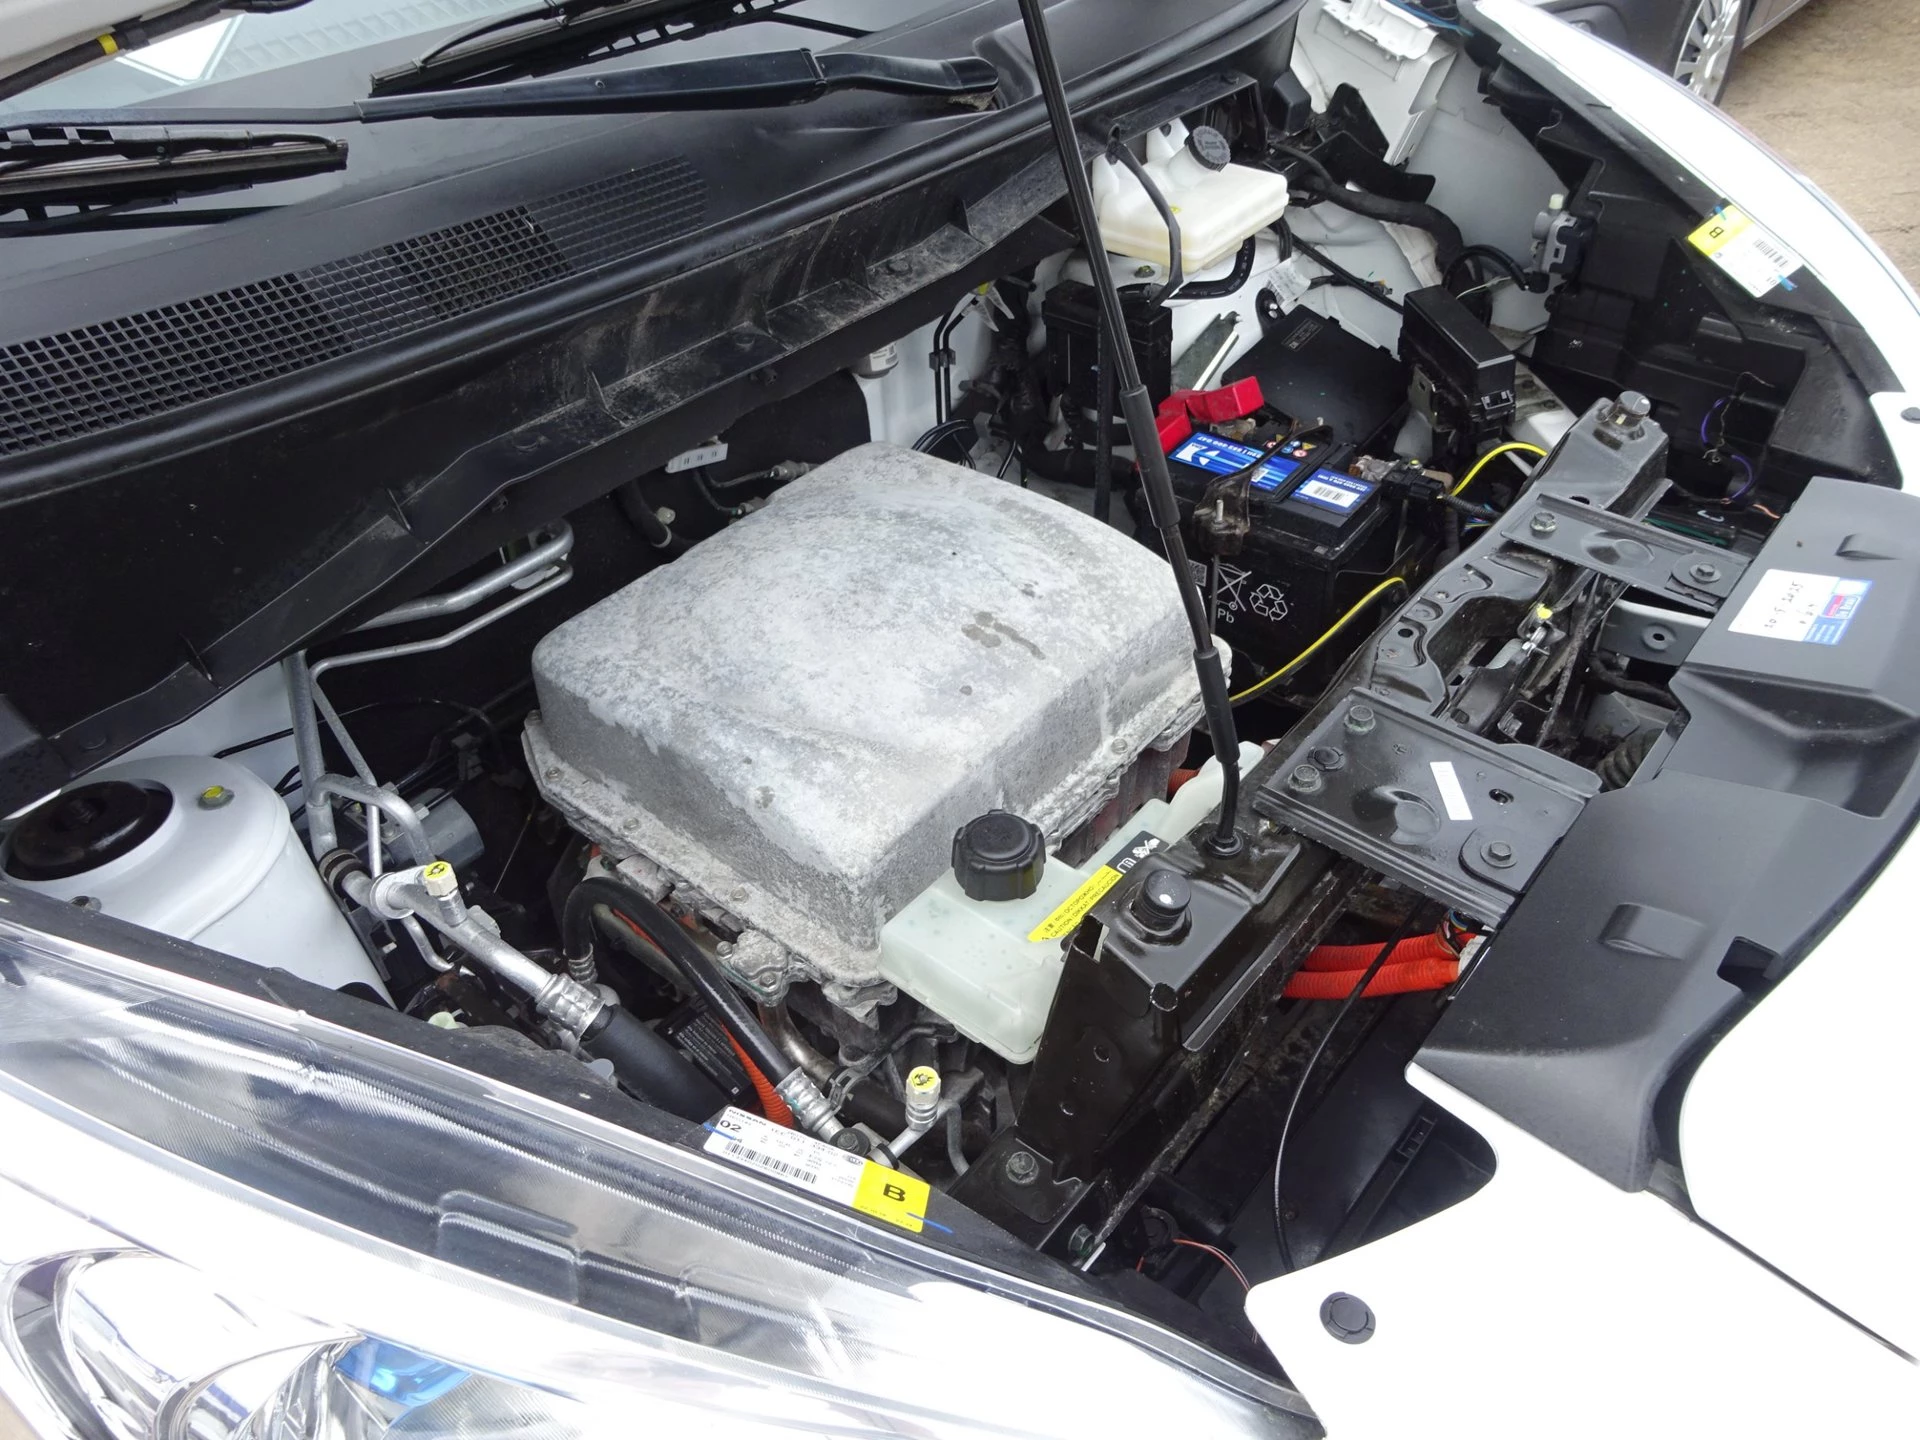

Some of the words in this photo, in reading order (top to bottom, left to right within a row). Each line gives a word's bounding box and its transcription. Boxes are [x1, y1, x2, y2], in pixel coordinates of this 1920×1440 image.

[1709, 226, 1725, 239] B
[1217, 608, 1235, 624] Pb
[1051, 918, 1073, 938] CAUTION
[720, 1119, 742, 1133] 02
[883, 1183, 906, 1202] B
